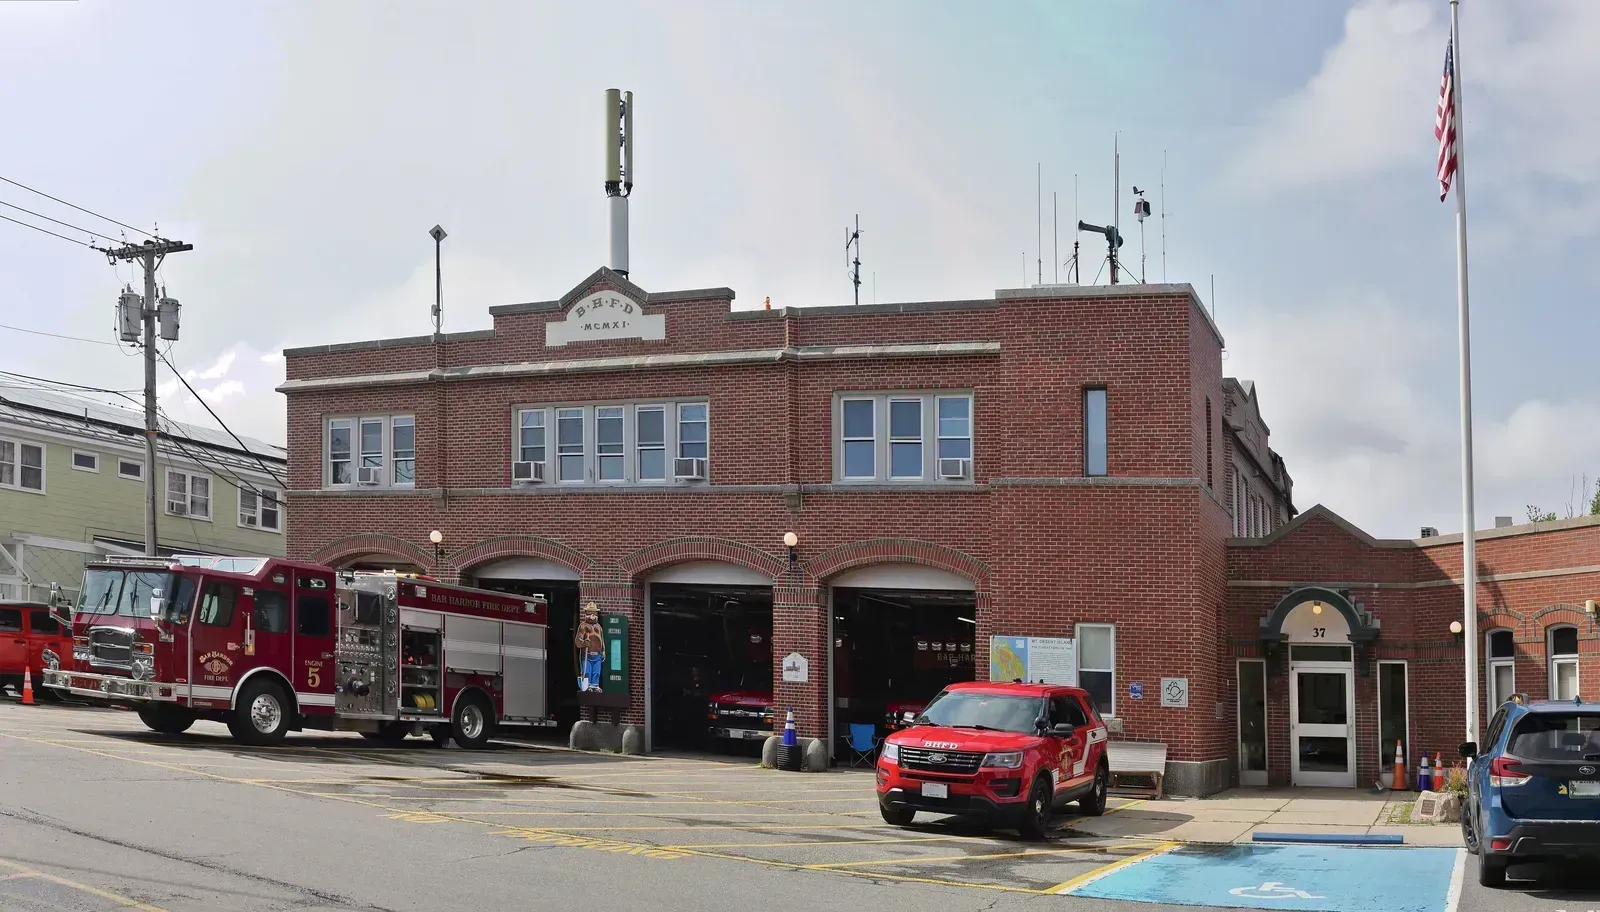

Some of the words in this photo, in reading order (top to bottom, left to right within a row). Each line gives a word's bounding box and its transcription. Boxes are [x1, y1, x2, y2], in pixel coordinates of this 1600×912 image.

[431, 593, 448, 604] BAR
[449, 596, 481, 609] HARBOR
[481, 601, 500, 611] FIRE
[501, 603, 521, 614] DEPT.
[1312, 627, 1326, 638] 37
[304, 659, 324, 668] ENGINE
[307, 667, 321, 688] 5
[924, 740, 959, 750] BHFD
